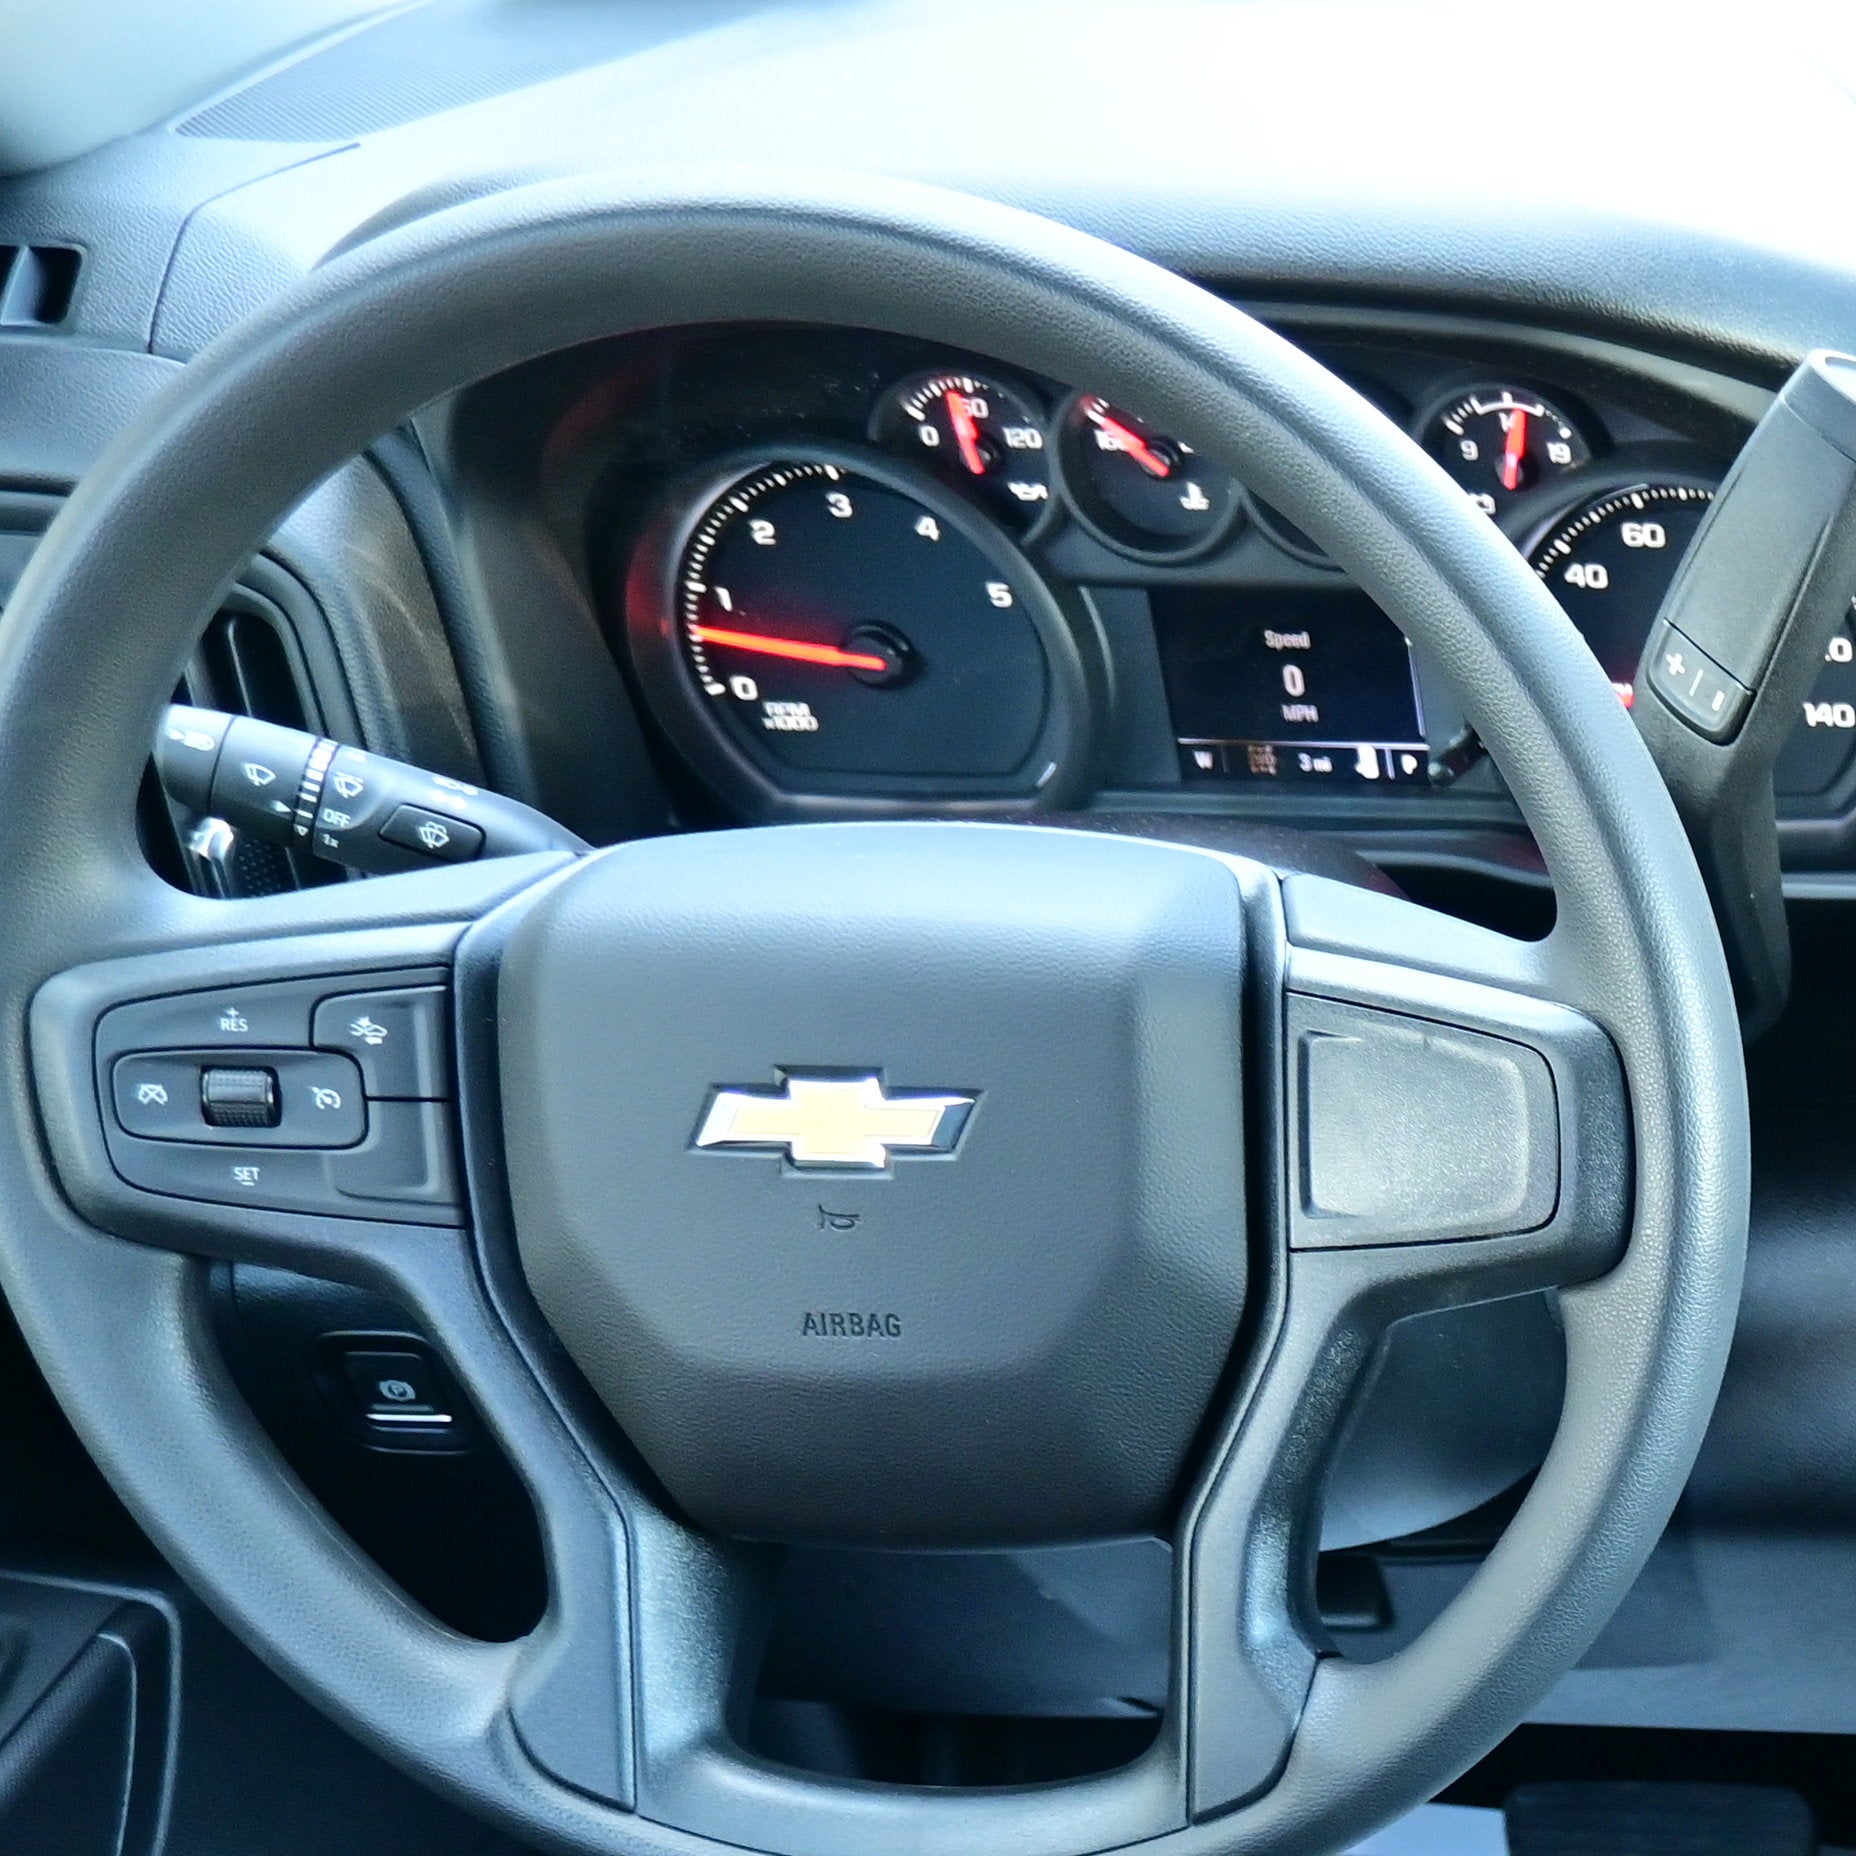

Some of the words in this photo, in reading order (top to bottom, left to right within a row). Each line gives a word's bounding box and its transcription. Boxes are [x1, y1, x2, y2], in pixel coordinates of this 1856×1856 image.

[919, 424, 939, 446] 0
[1003, 426, 1043, 449] 120
[1460, 440, 1478, 461] 9
[1547, 442, 1571, 464] 19
[826, 492, 853, 517] 3
[750, 519, 776, 545] 2
[914, 516, 939, 541] 4
[1622, 522, 1666, 547] 60
[1564, 564, 1609, 589] 40
[714, 586, 733, 611] 1
[985, 582, 1013, 608] 5
[1264, 630, 1311, 650] Speed
[730, 675, 758, 700] 0
[1282, 664, 1305, 697] 0
[1281, 704, 1319, 723] MPH
[1802, 702, 1855, 728] 140
[1299, 753, 1312, 772] 3
[323, 808, 351, 827] OFF
[219, 1018, 249, 1033] RES
[233, 1168, 260, 1182] SET
[801, 1312, 902, 1338] AIRBAG
